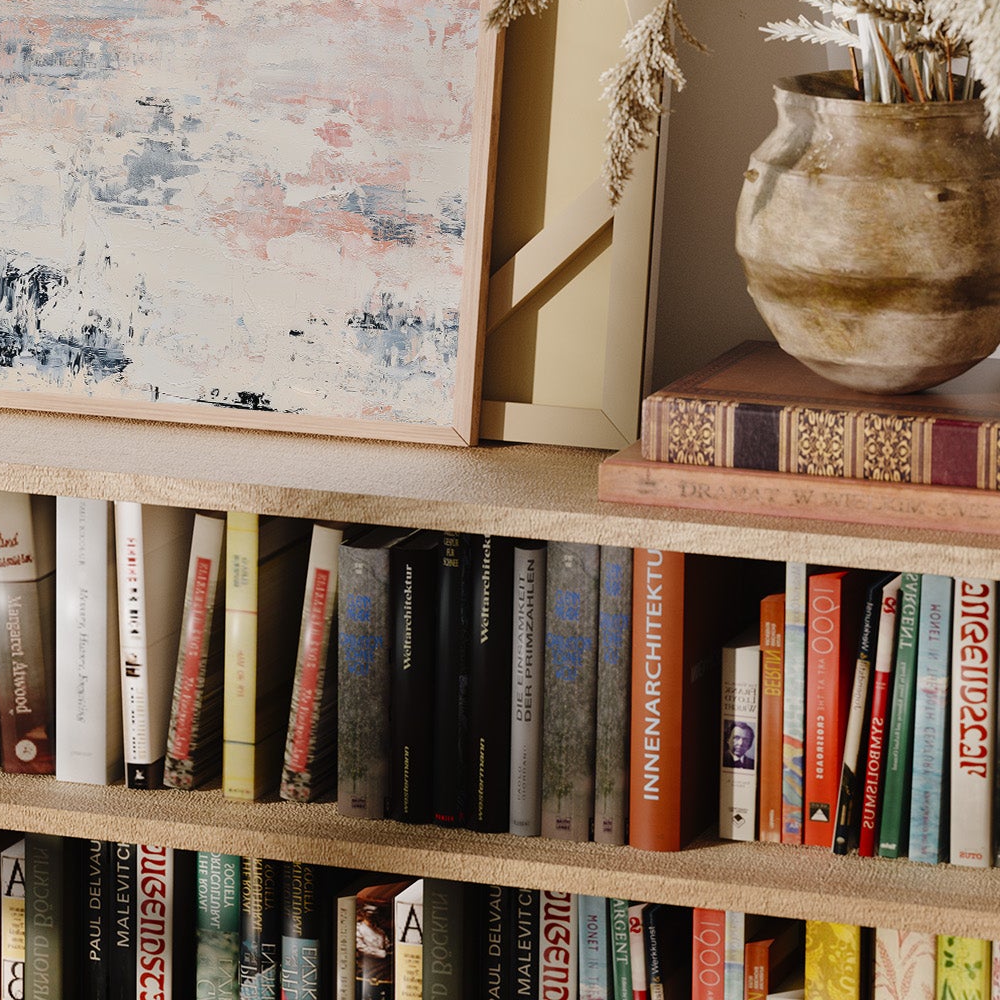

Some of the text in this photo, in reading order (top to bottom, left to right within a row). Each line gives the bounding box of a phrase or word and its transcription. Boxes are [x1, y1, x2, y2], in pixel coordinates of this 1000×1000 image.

[792, 489, 814, 505] W
[403, 564, 412, 670] Weltarchitektur
[480, 535, 491, 644] Weltarchitek
[6, 594, 33, 715] Margaret Atwood
[516, 577, 526, 689] EINSAMKEIT
[525, 559, 535, 722] DER PRIMZAHLEN
[643, 549, 664, 801] INNENARCHITEKTU
[5, 858, 26, 897] A
[89, 839, 101, 961] PAUL DELVAU
[401, 903, 423, 942] A
[489, 885, 502, 959] DELVAU
[587, 914, 599, 971] MONET IN
[612, 899, 629, 965] ARGENT
[650, 926, 660, 974] Werkkunst
[695, 920, 720, 988] 1900
